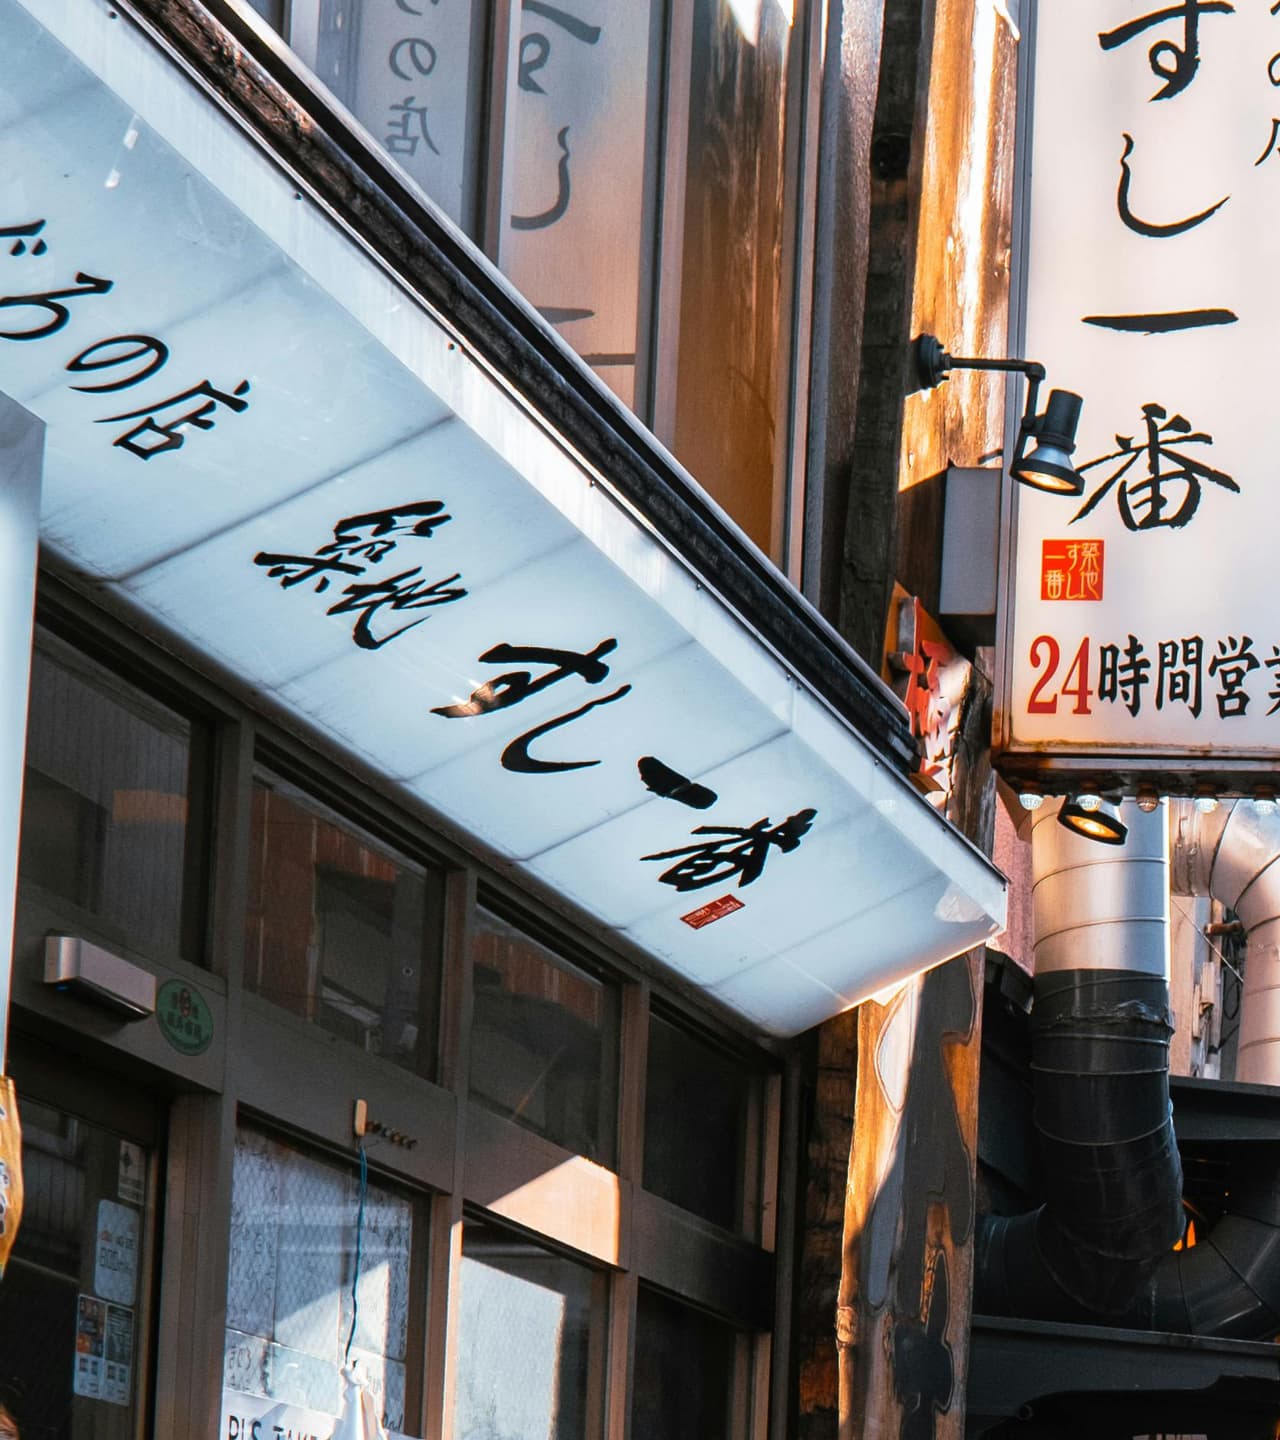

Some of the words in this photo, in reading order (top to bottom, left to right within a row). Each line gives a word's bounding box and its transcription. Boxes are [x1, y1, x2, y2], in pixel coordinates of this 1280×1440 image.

[254, 499, 818, 893] 築地すし一番
